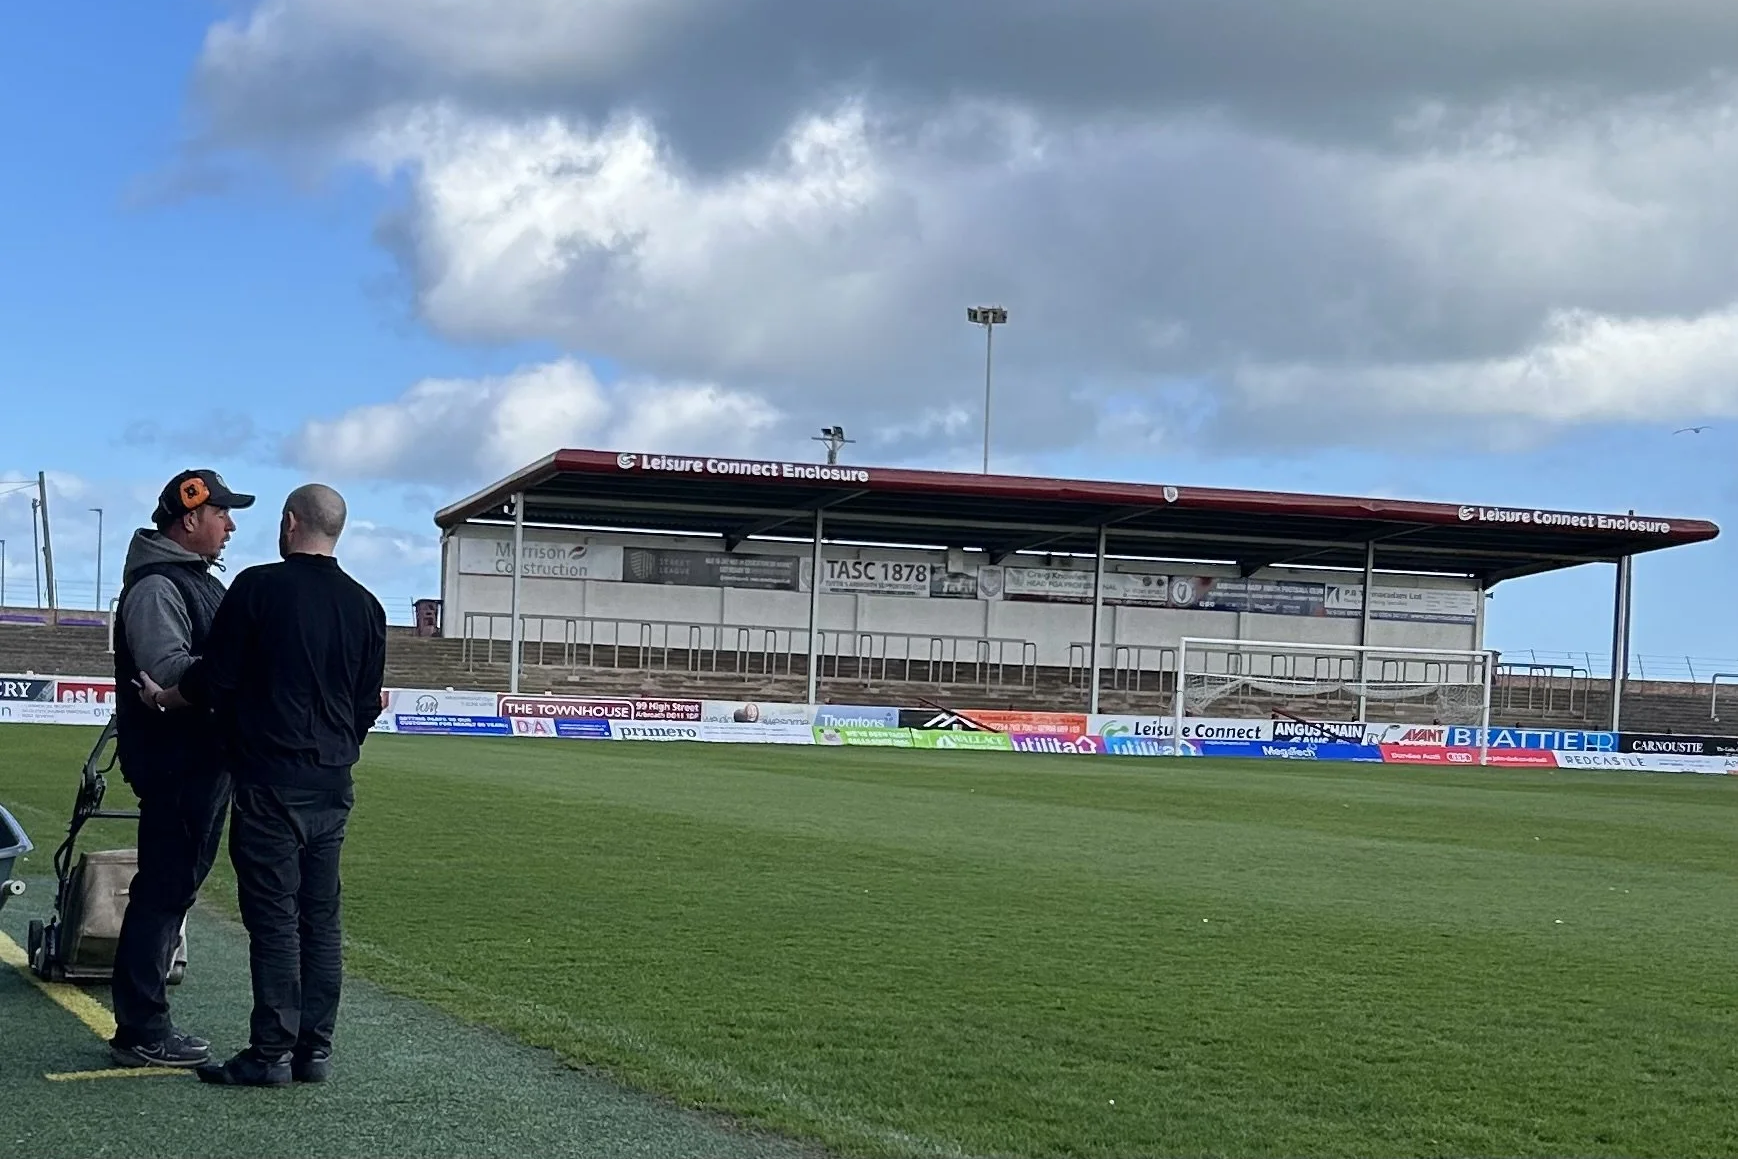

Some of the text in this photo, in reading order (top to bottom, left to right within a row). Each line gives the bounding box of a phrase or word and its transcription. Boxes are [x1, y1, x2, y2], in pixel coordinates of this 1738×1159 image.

[641, 455, 870, 483] Leisure Connect Enclosure
[1478, 507, 1671, 534] Leisure Connect Enclosure
[495, 559, 588, 577] Costruction
[826, 559, 927, 583] TASC 1878
[505, 703, 630, 719] THE TOWNHOUSE
[635, 701, 699, 713] 99 High Street
[619, 724, 697, 739] primero
[1134, 720, 1262, 740] Leisue Connect
[1275, 722, 1321, 737] ANGUS
[1400, 728, 1445, 742] AVANT
[951, 733, 1004, 744] WALLACE
[1013, 735, 1078, 754] utilita
[1454, 728, 1579, 750] BEATTIE
[1632, 740, 1704, 753] CARNOUSTIE
[1565, 755, 1647, 767] REDCASTLE
